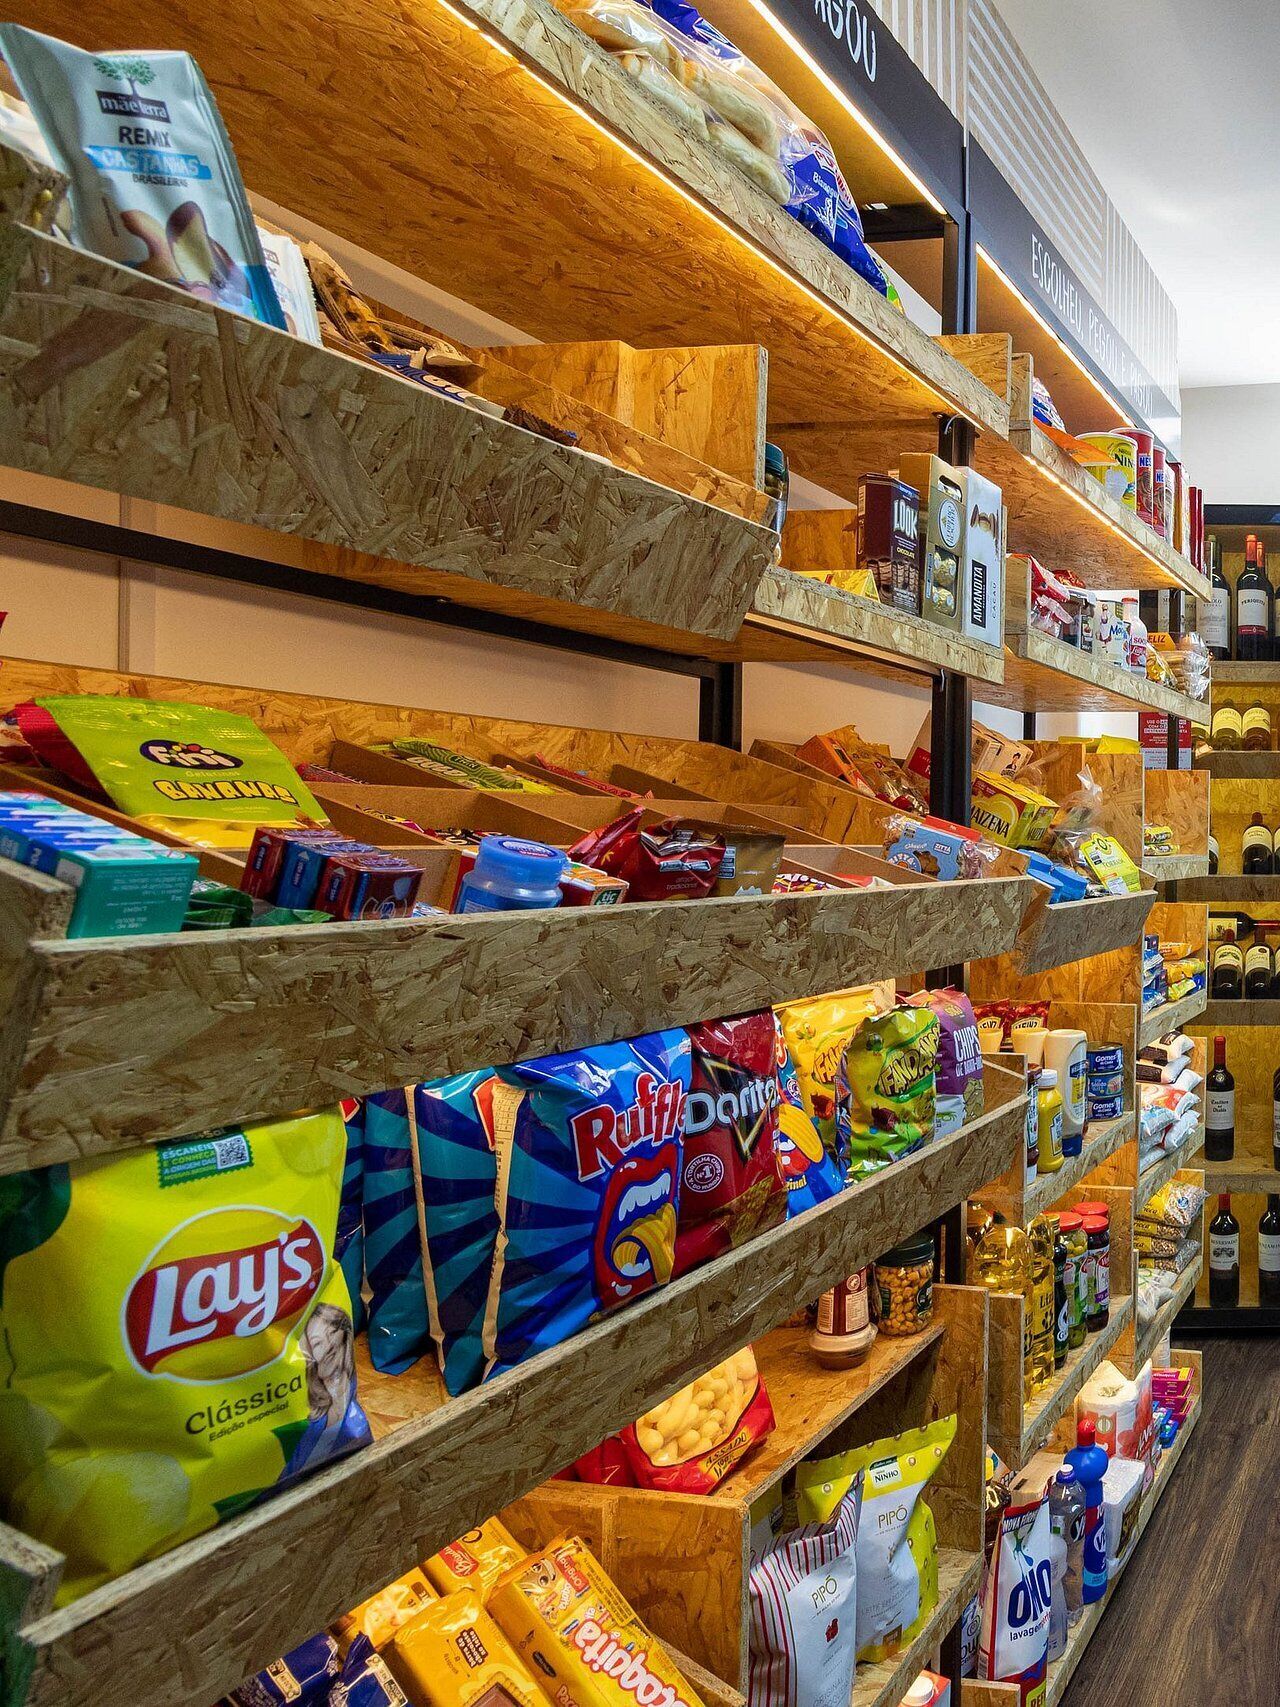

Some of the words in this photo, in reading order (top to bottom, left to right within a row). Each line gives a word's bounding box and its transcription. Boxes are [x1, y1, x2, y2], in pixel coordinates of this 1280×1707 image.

[119, 125, 172, 148] REMIX
[1032, 233, 1084, 340] ESCOLHEU,
[893, 499, 918, 540] LOOK
[973, 566, 984, 622] AMANDITA
[147, 745, 236, 768] Fini
[153, 780, 300, 807] BANANAS
[601, 890, 616, 900] tic
[953, 1025, 981, 1062] CHIPS
[1095, 1054, 1117, 1063] Gomes
[684, 1078, 778, 1136] Dorito
[146, 1232, 313, 1356] Lay's
[185, 1375, 303, 1435] Clássica
[209, 1421, 245, 1442] Edição
[246, 1402, 290, 1426] especial
[875, 1469, 899, 1483] NINHO
[878, 1504, 909, 1529] PIPÓ
[558, 1556, 584, 1590] Original
[811, 1574, 838, 1610] PIPÓ
